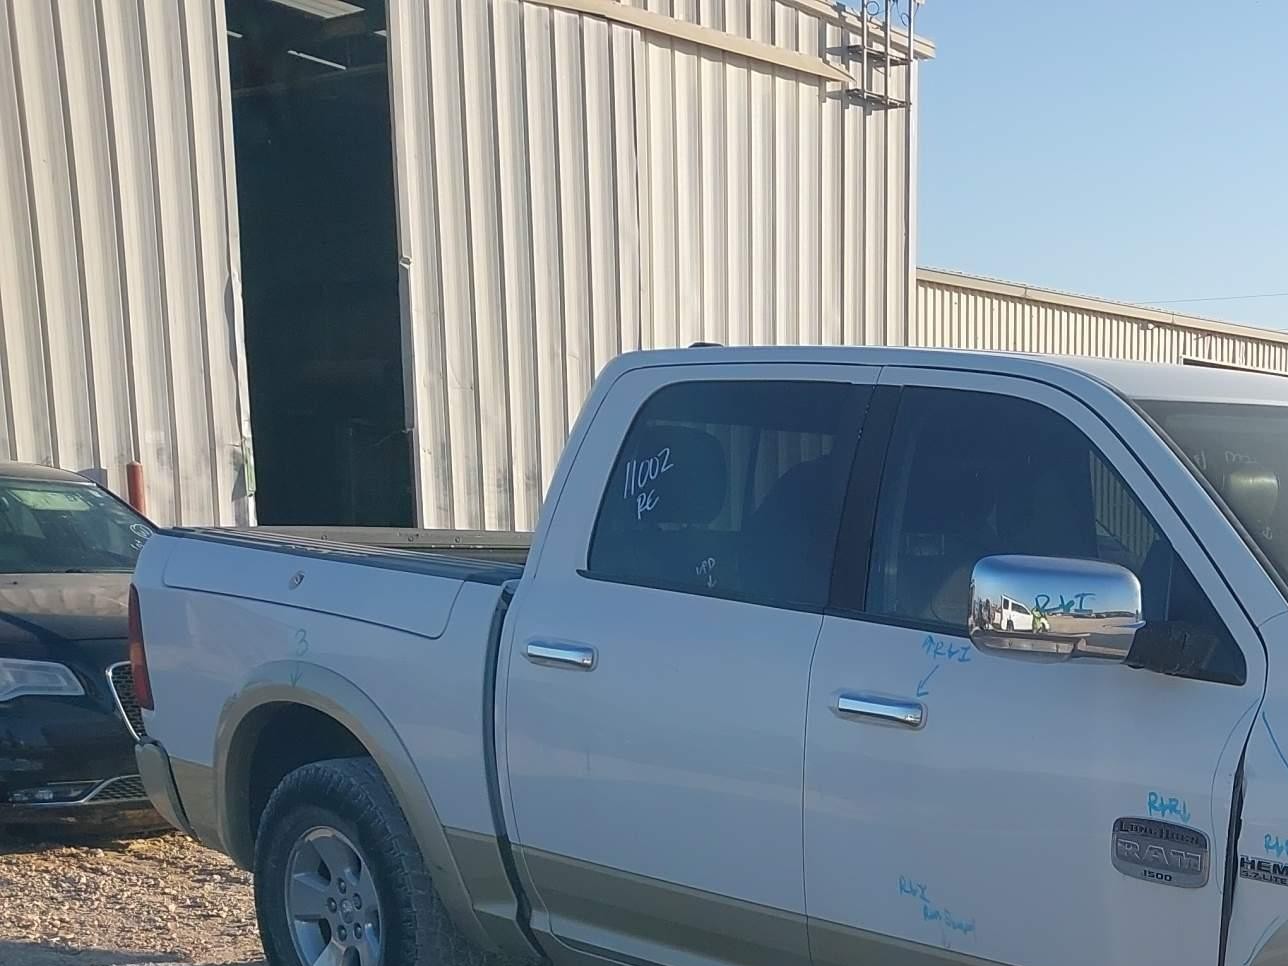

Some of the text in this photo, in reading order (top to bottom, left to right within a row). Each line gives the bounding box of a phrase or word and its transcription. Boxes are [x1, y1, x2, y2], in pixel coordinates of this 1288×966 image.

[624, 447, 675, 499] 11002
[1116, 837, 1202, 873] RAM
[1142, 869, 1173, 882] 1500
